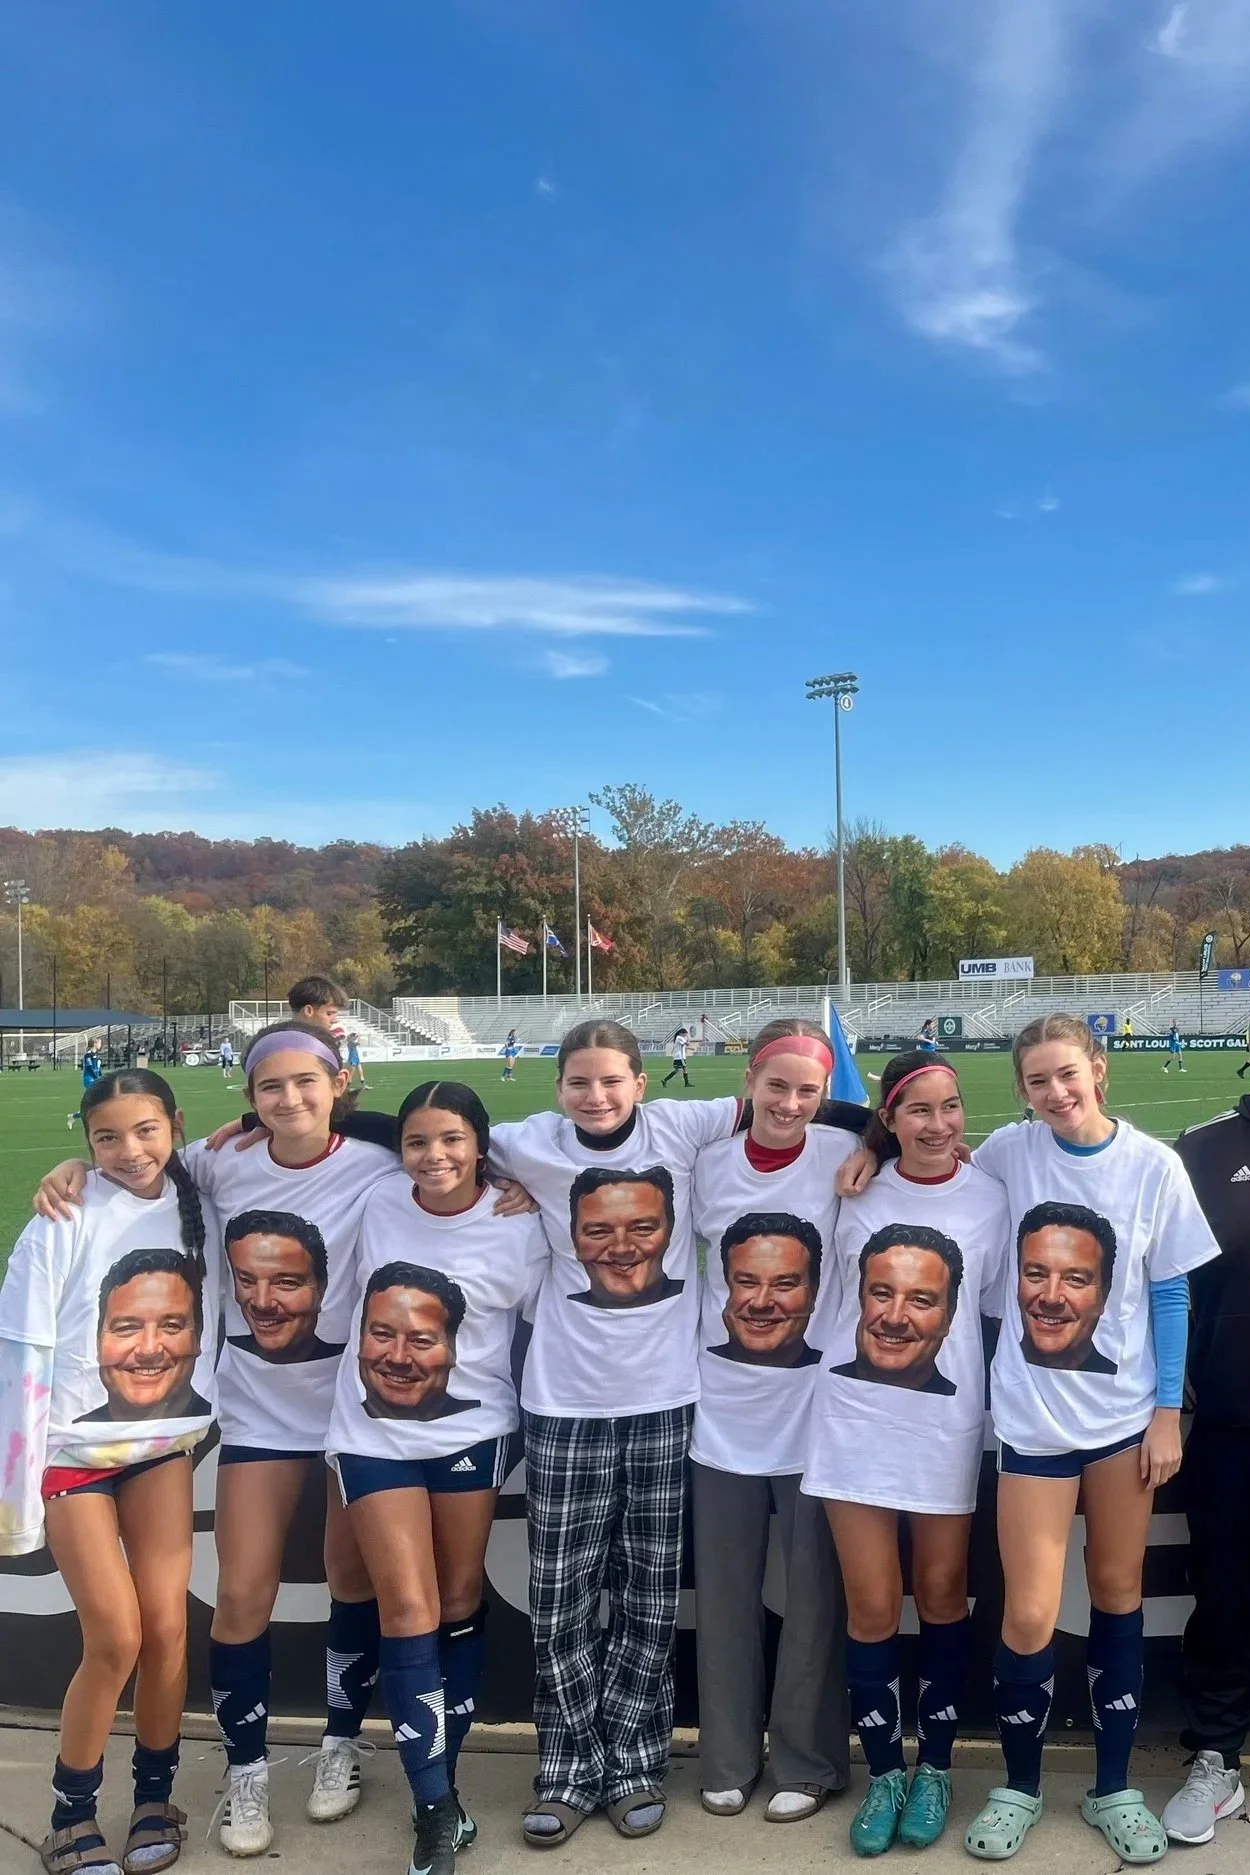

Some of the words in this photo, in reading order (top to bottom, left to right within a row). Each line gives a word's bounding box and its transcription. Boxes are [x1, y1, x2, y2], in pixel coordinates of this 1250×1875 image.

[961, 963, 997, 974] UMB
[1004, 961, 1031, 973] BANK
[1189, 1039, 1225, 1048] SCOTT
